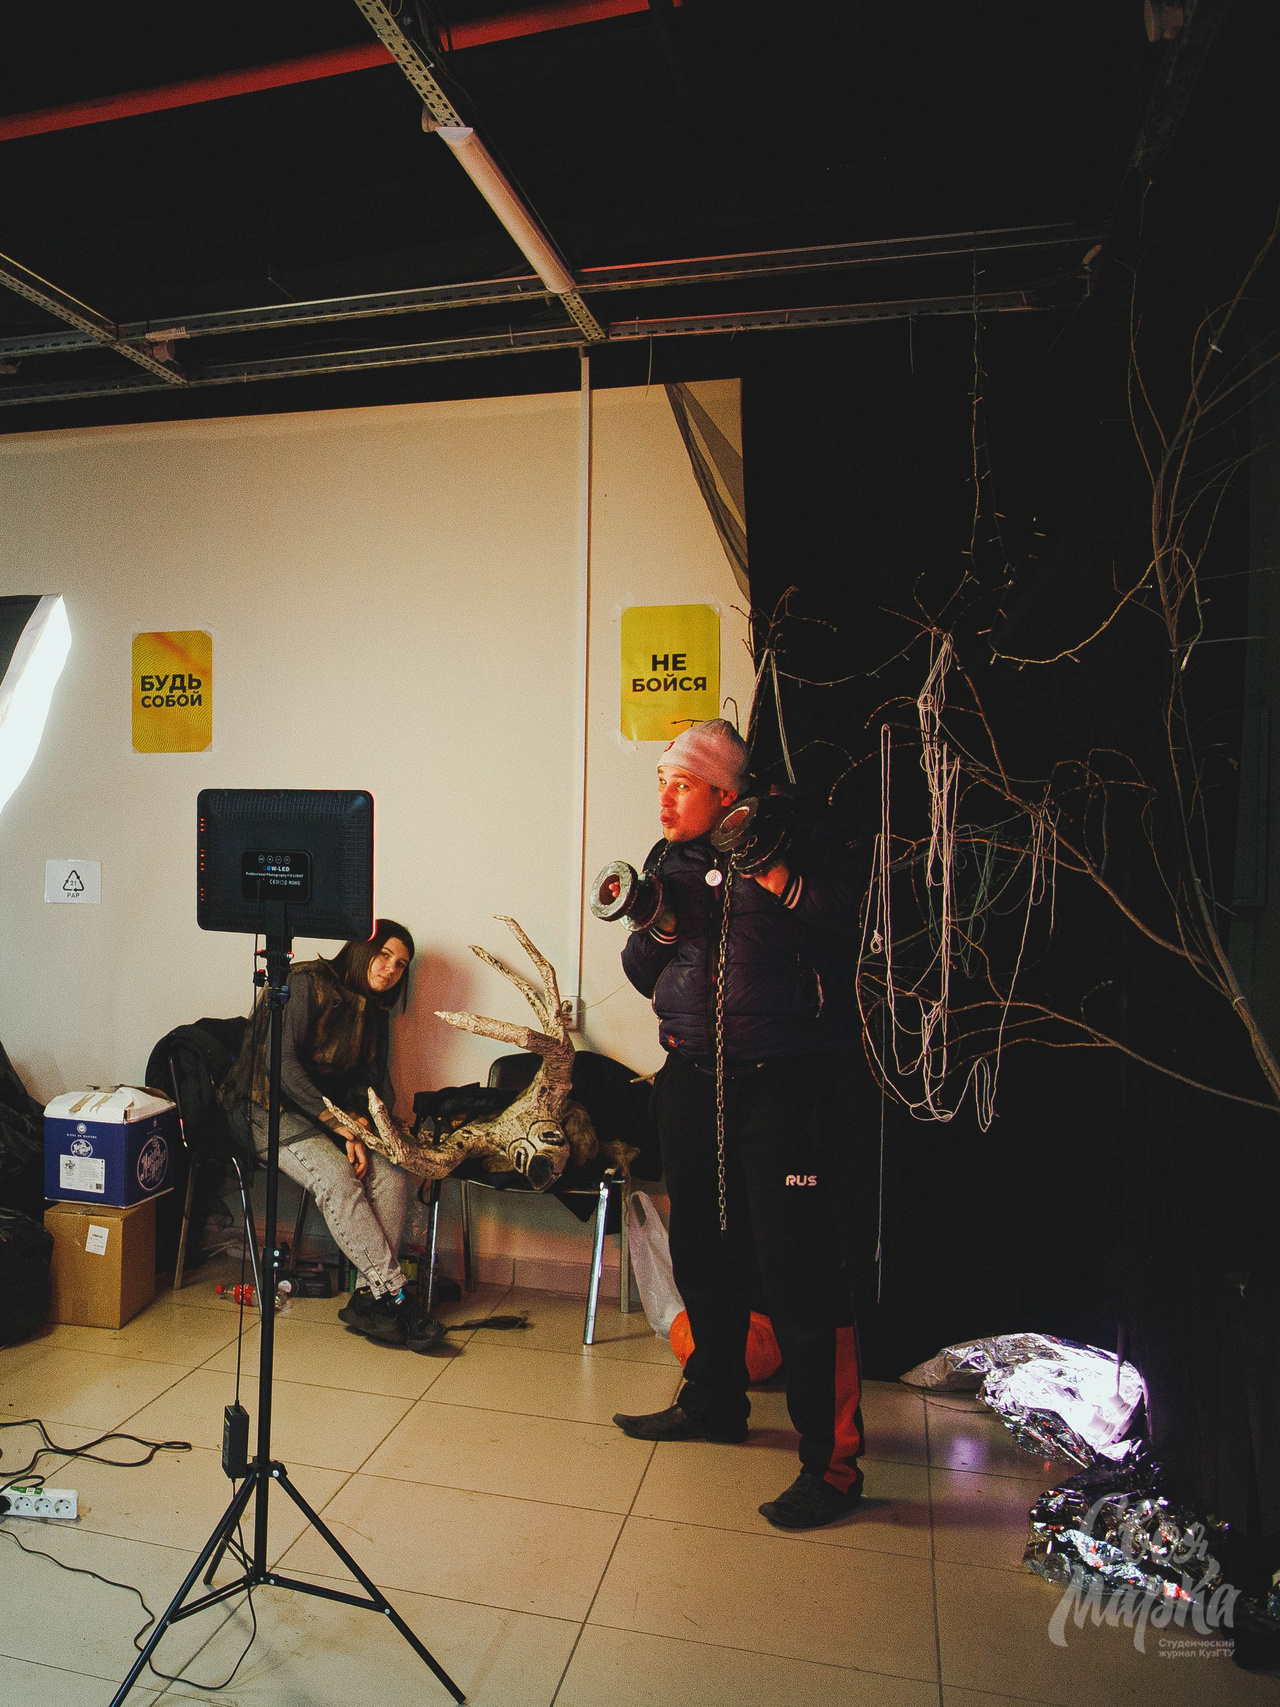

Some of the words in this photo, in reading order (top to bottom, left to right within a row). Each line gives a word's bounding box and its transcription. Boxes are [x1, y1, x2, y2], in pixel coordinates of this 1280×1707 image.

[651, 653, 687, 671] НЕ
[140, 673, 202, 694] БУДЬ
[632, 673, 707, 692] БОЙСЯ
[140, 690, 203, 708] СОБОЙ
[785, 1174, 818, 1187] RUS
